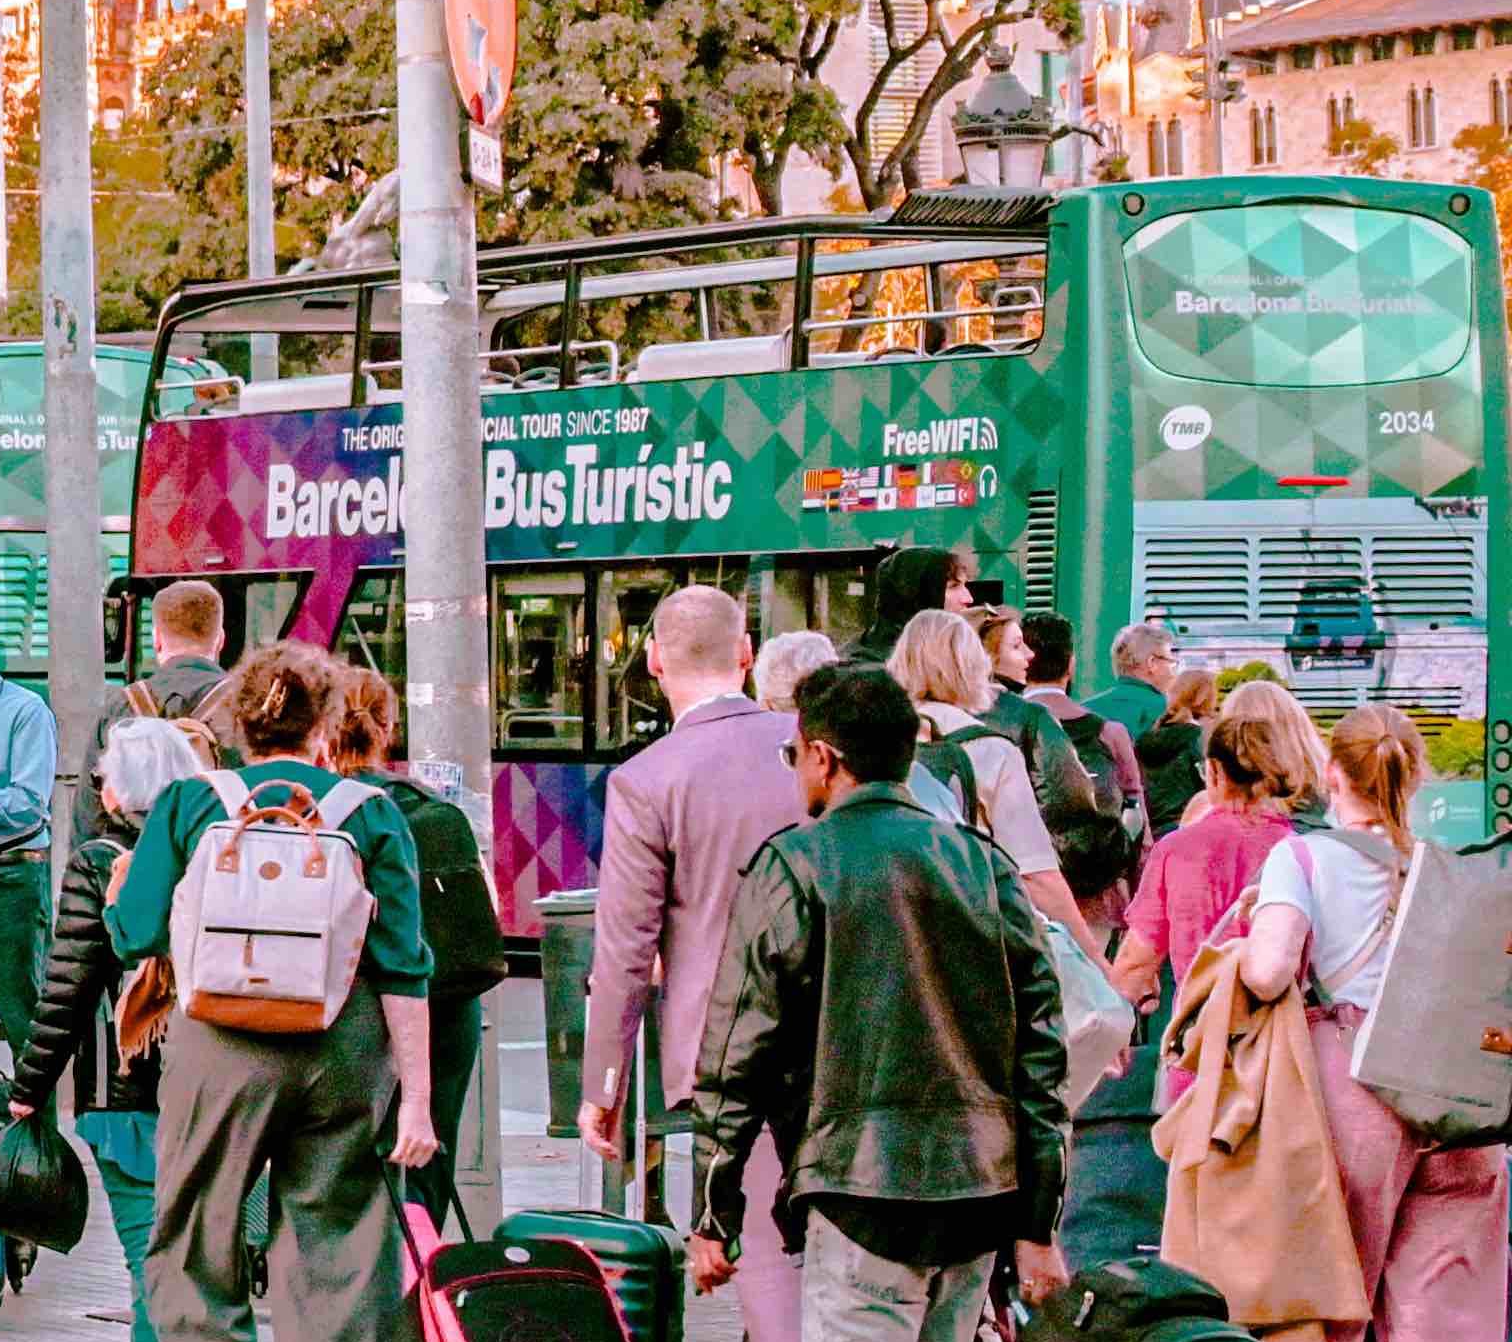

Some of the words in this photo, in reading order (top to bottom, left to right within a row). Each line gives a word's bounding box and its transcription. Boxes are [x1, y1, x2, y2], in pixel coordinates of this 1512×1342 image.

[343, 426, 371, 452] THE
[372, 422, 405, 450] ORIG
[481, 416, 519, 443] ICIAL
[520, 412, 561, 440] TOUR
[566, 409, 612, 437] SINCE
[614, 407, 651, 433] 1987
[1170, 422, 1205, 435] TMB
[1379, 410, 1435, 435] 2034
[266, 454, 406, 540] Barcel
